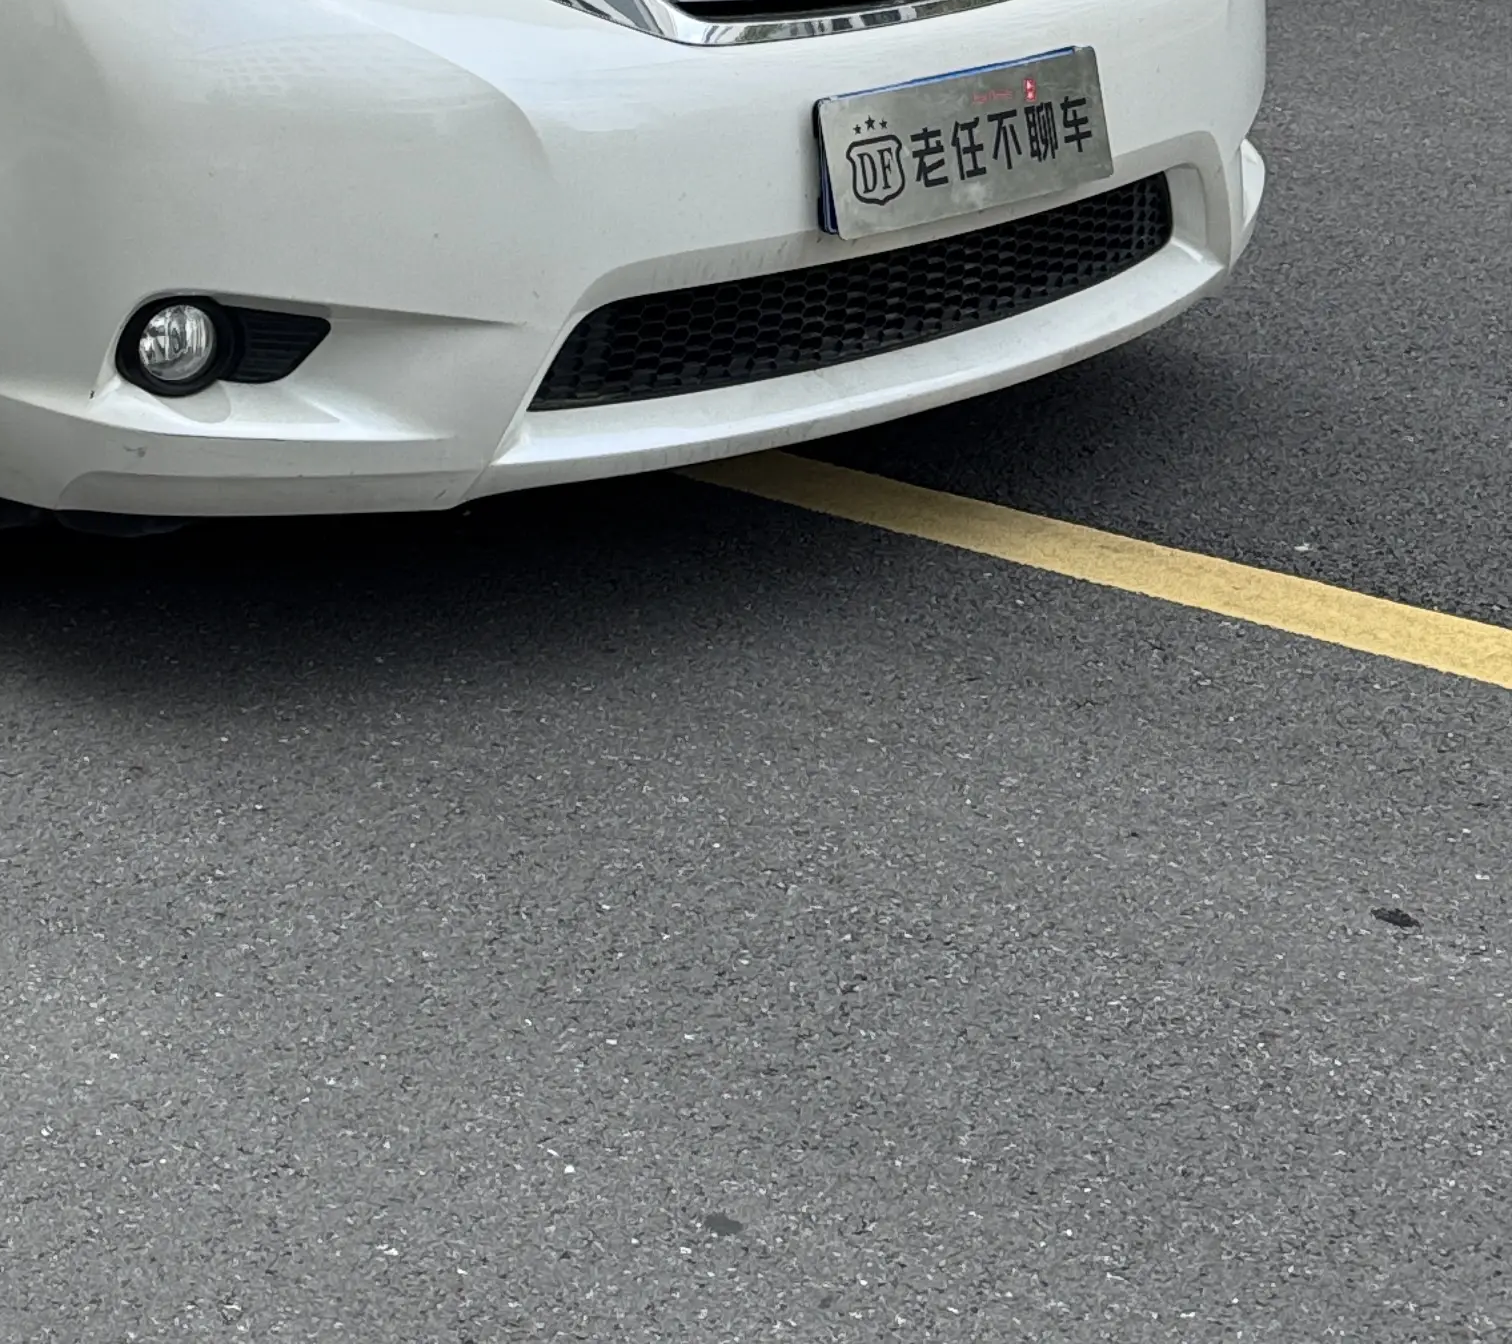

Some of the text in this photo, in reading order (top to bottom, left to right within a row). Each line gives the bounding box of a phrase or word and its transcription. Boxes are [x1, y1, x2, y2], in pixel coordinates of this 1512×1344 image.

[857, 147, 894, 194] DF
[910, 96, 1092, 188] 老任不聊车
